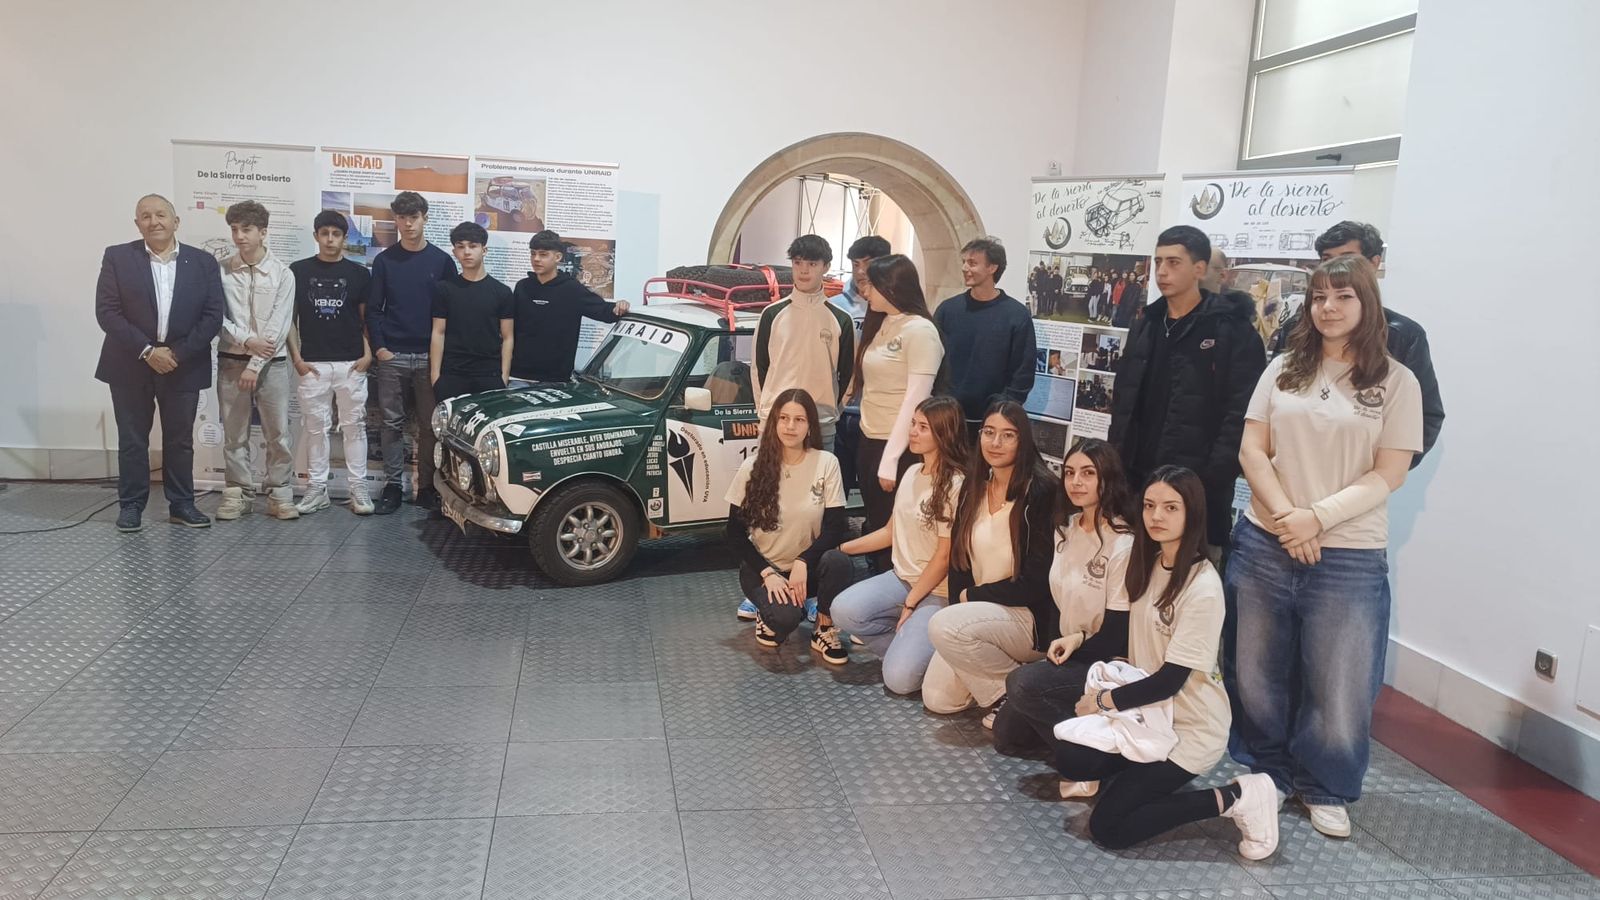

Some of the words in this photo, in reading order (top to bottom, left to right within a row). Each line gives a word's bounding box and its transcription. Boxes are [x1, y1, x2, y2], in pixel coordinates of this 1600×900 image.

[197, 170, 210, 179] De
[210, 170, 218, 179] la
[219, 172, 245, 180] Sierra
[246, 172, 254, 181] al
[255, 173, 291, 183] Desierto
[481, 163, 517, 171] Problemas
[518, 165, 555, 173] mecánicos
[556, 167, 583, 175] durante
[1033, 192, 1045, 205] De
[1051, 187, 1060, 199] la
[1065, 181, 1092, 196] sierra
[1229, 181, 1252, 198] De
[1260, 180, 1274, 197] la
[1281, 183, 1329, 198] sierra
[1036, 204, 1046, 220] al
[1049, 196, 1090, 217] desierto
[1248, 198, 1267, 216] al
[1270, 195, 1344, 217] desierto
[314, 298, 343, 307] KENZO
[731, 422, 760, 437] UNIR
[531, 440, 558, 452] CASTILLA
[589, 433, 603, 443] AYER
[550, 446, 576, 458] ENVUELTA
[576, 445, 585, 453] EN
[584, 443, 596, 452] SUS
[553, 455, 582, 466] DESPRECIA
[582, 450, 603, 461] CUANTO
